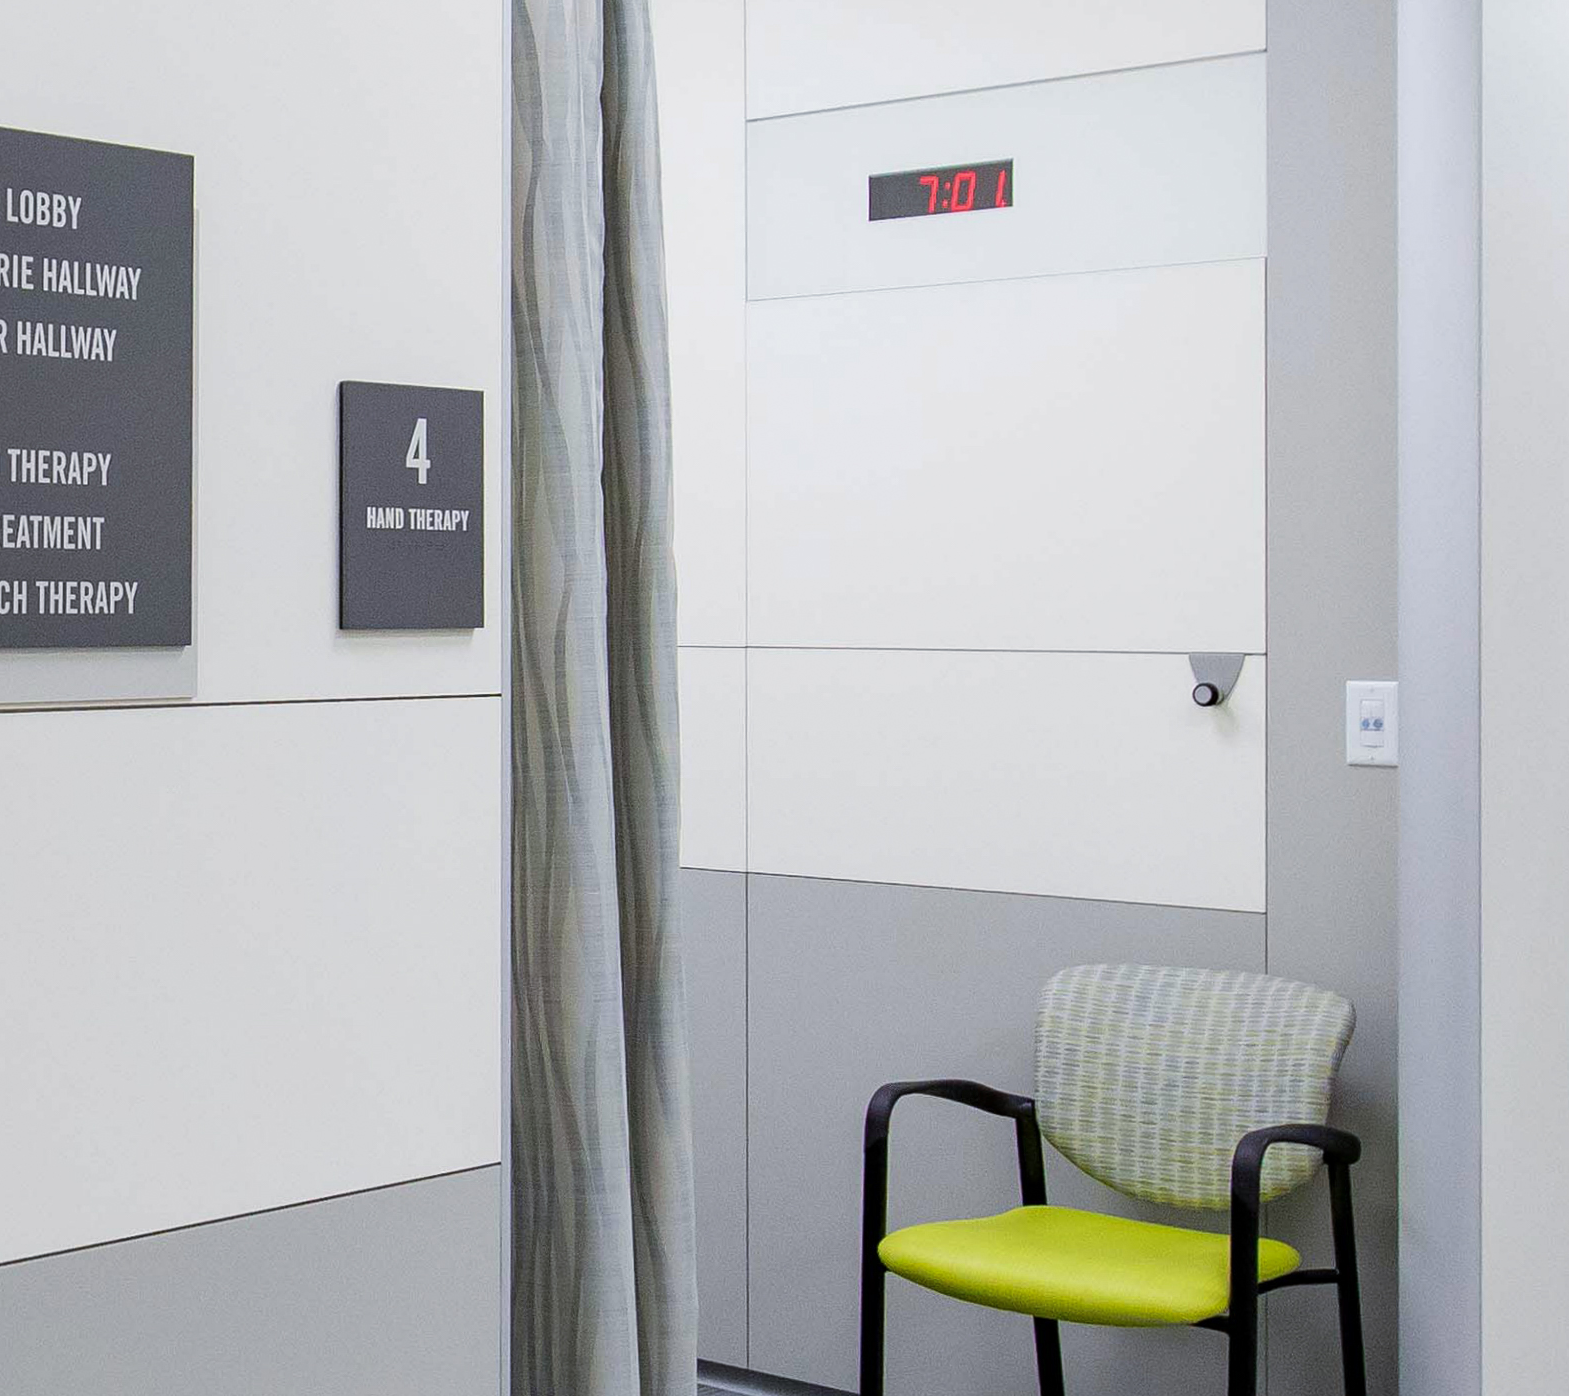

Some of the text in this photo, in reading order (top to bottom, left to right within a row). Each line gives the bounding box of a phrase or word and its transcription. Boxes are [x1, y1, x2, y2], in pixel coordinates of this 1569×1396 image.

[6, 187, 82, 230] LOBBY
[919, 169, 1007, 214] 7:01
[42, 257, 142, 301] HALLWAY
[16, 320, 117, 362] HALLWAY
[7, 448, 112, 487] THERAPY
[405, 417, 431, 485] 4
[366, 506, 470, 532] HAND THERAPY
[35, 580, 139, 615] THERAPY
